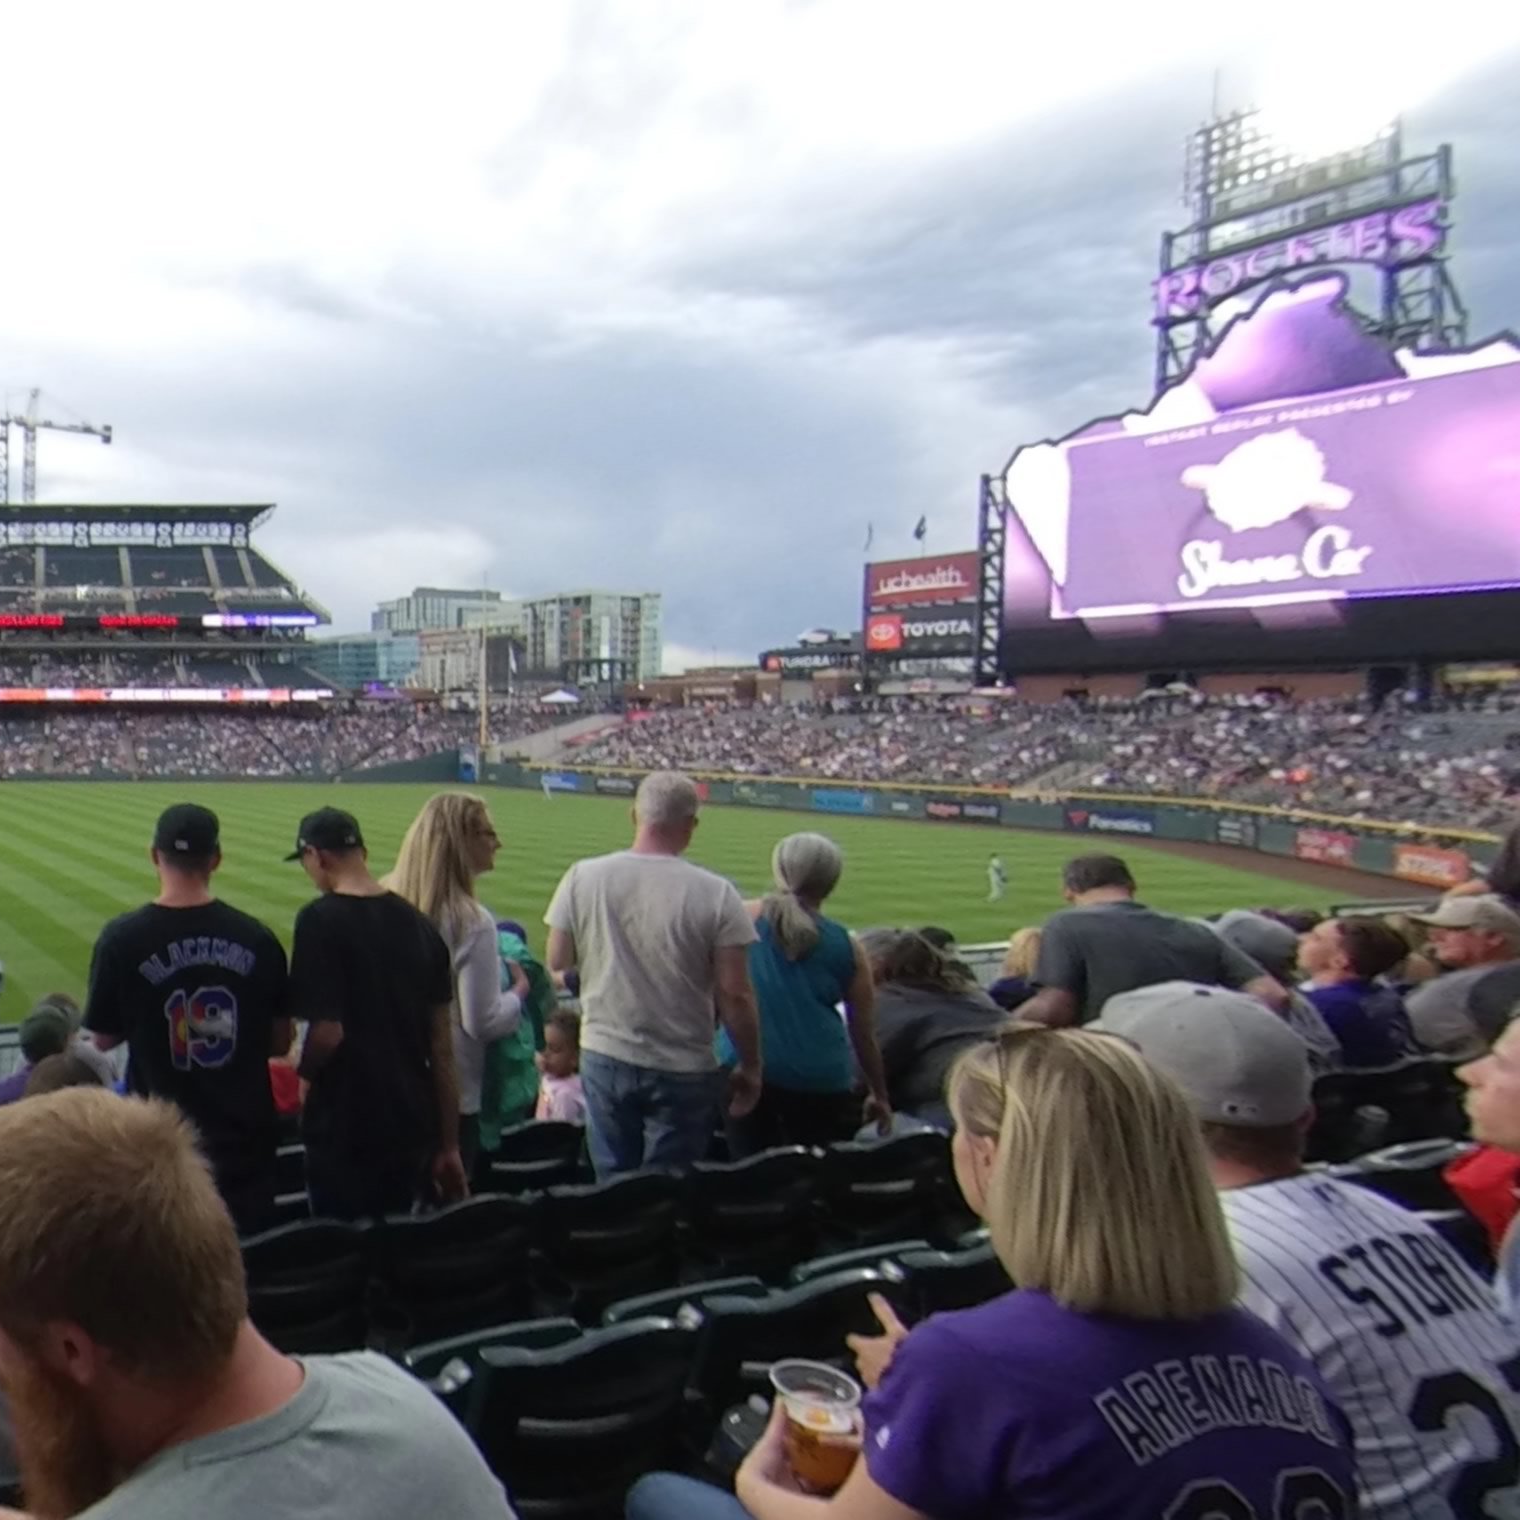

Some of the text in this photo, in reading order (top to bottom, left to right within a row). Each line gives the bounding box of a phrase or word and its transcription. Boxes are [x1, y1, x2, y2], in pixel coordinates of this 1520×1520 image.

[1157, 198, 1445, 314] ROCKIES
[1211, 415, 1274, 434] REPLAY
[1277, 395, 1381, 422] PRESENTED
[879, 562, 962, 594] uchealth
[901, 619, 972, 638] TOYOTA
[137, 935, 257, 987] BLACKMON
[164, 984, 239, 1073] 19
[1318, 1232, 1500, 1338] STORY
[1093, 1353, 1340, 1467] ARENADO
